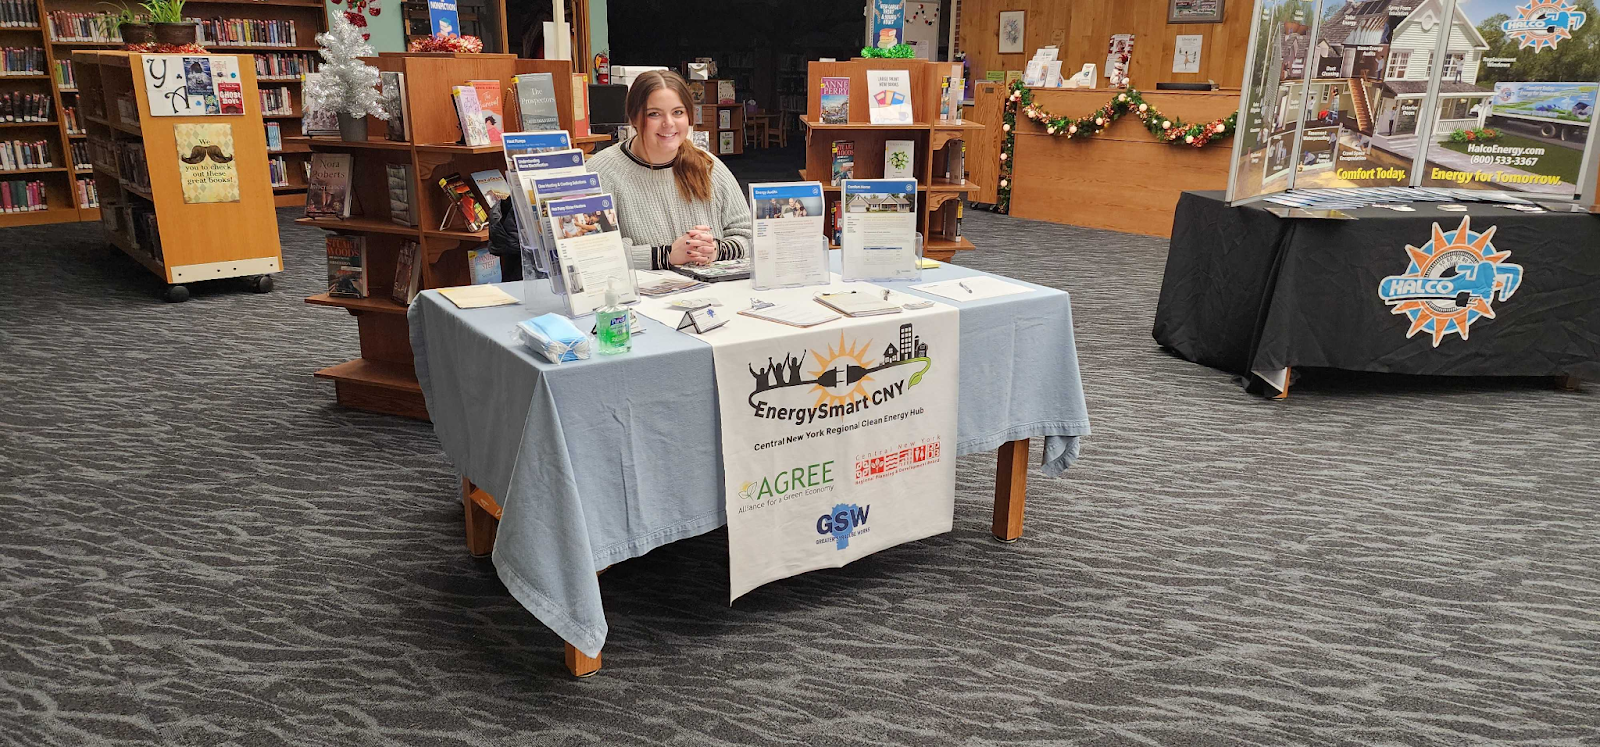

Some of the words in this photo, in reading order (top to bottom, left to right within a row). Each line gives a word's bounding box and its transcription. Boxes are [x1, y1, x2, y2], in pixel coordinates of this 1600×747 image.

[1507, 20, 1546, 30] HALCO
[146, 58, 167, 89] Y
[164, 85, 190, 114] A
[522, 98, 556, 106] Prospectors
[1468, 144, 1546, 156] HalcoEnergy.com
[320, 160, 340, 168] Nora
[1470, 155, 1494, 165] (800)
[1495, 156, 1538, 166] 533-3367
[312, 171, 345, 180] Roberts
[1336, 168, 1374, 180] Comfort
[1376, 167, 1406, 182] Today.
[1431, 168, 1475, 184] Energy
[1475, 170, 1494, 182] for
[1496, 171, 1562, 186] Tomorrow.
[327, 240, 358, 250] STUART
[327, 248, 360, 257] WOODS
[1389, 280, 1454, 296] HALCO
[754, 395, 868, 425] EnergySmart
[872, 380, 904, 406] CNY
[754, 438, 785, 451] Central
[786, 434, 804, 444] New
[806, 430, 824, 439] York
[826, 421, 860, 436] Regional
[862, 418, 883, 428] Clean
[884, 412, 909, 423] Energy
[910, 407, 924, 416] Hub
[856, 447, 892, 460] Central
[922, 435, 940, 443] York
[757, 460, 834, 500] AGREE
[738, 502, 765, 514] Alliance
[784, 492, 802, 501] Green
[805, 484, 834, 496] Economy
[816, 504, 870, 535] GSW
